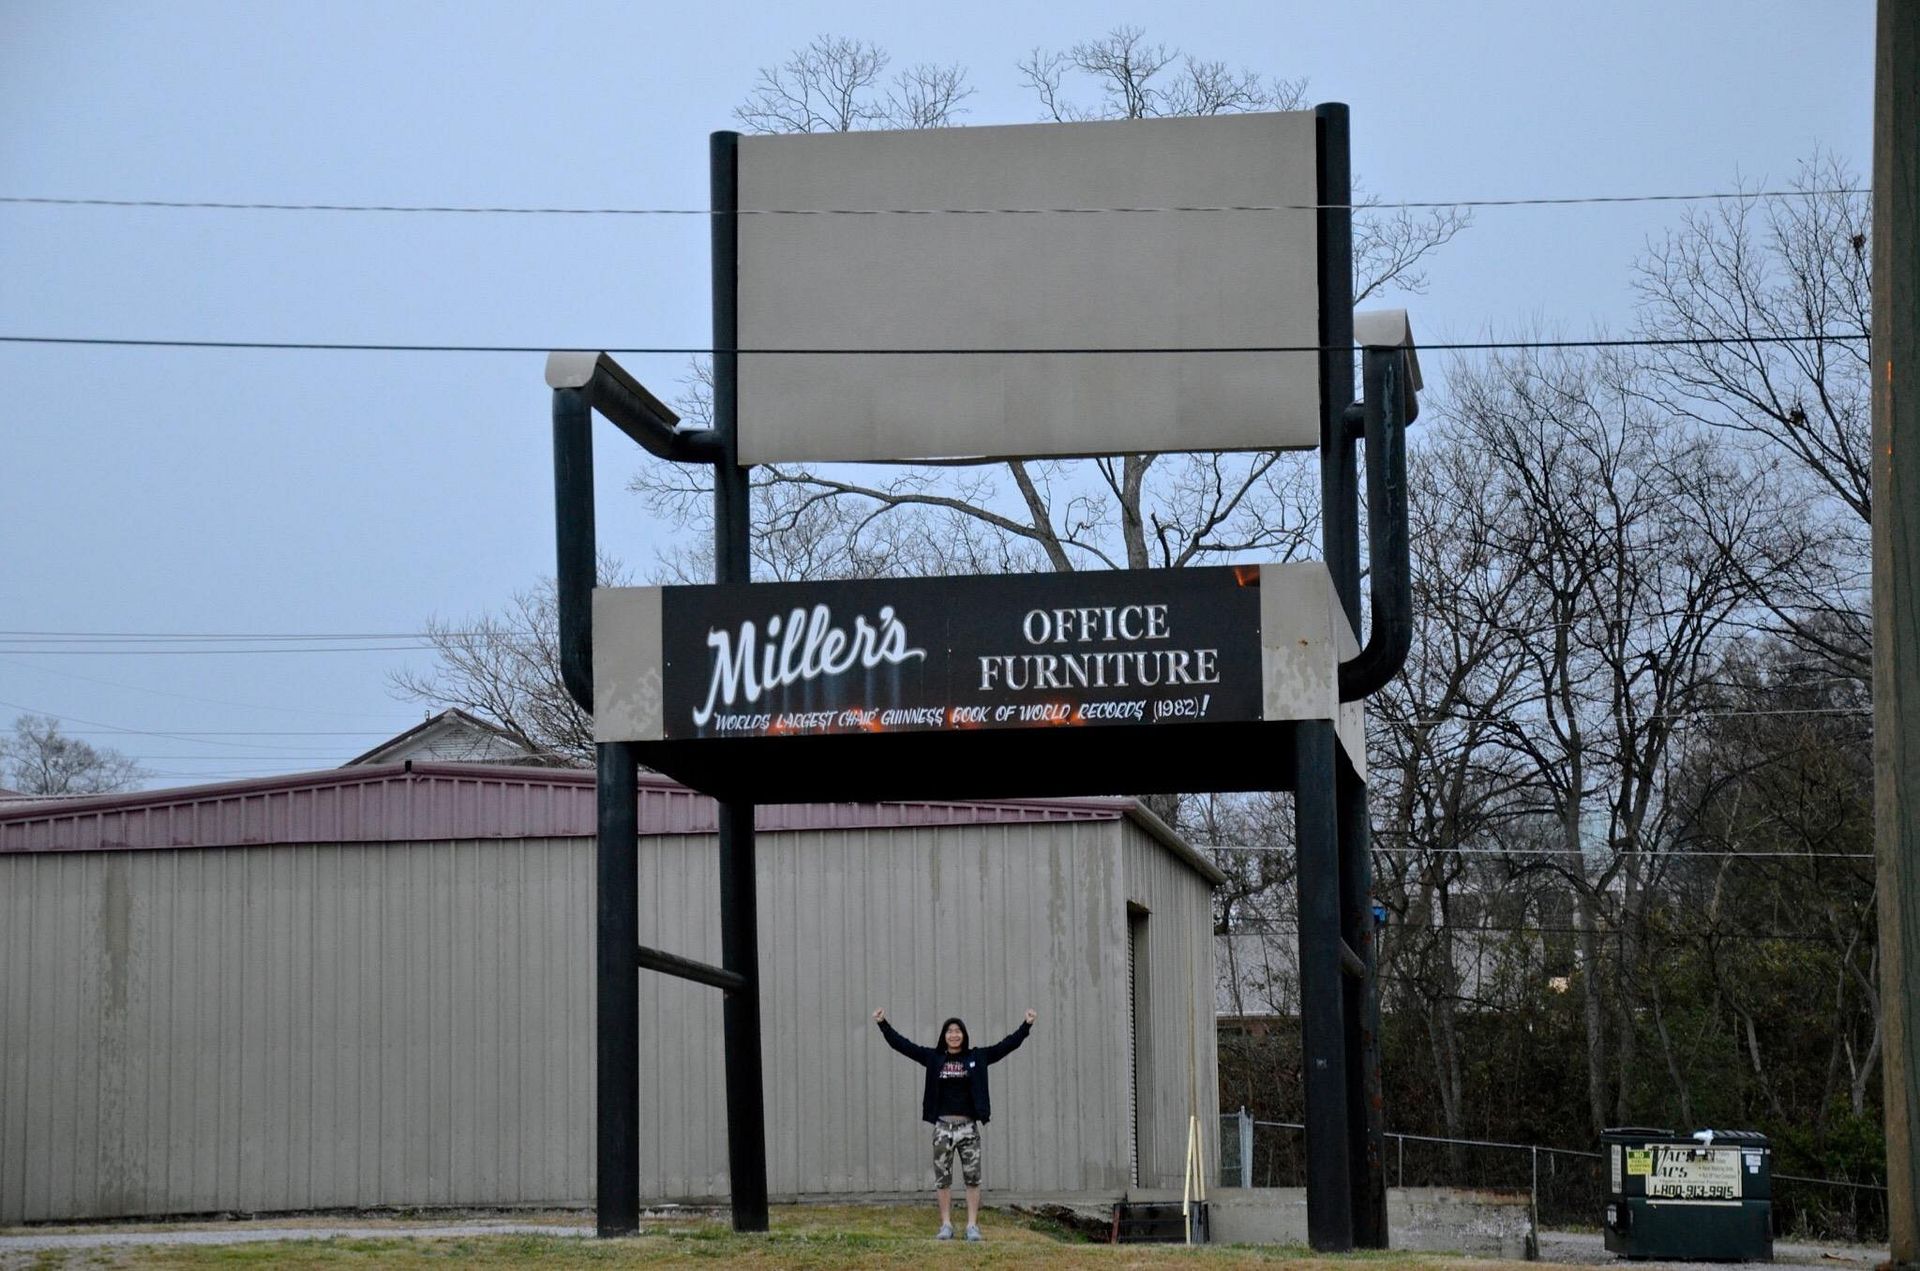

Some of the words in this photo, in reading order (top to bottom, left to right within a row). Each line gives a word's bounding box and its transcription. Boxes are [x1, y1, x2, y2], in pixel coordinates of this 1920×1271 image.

[1022, 604, 1171, 645] OFFICE
[693, 603, 926, 726] Miller's
[978, 648, 1221, 691] FURNITURE
[776, 710, 838, 731] LARGEST
[880, 706, 945, 727] GUINNESS
[951, 705, 991, 723] BOOK
[995, 705, 1016, 722] OF
[1019, 702, 1071, 721] WORLD
[1077, 700, 1147, 720] RECORDS
